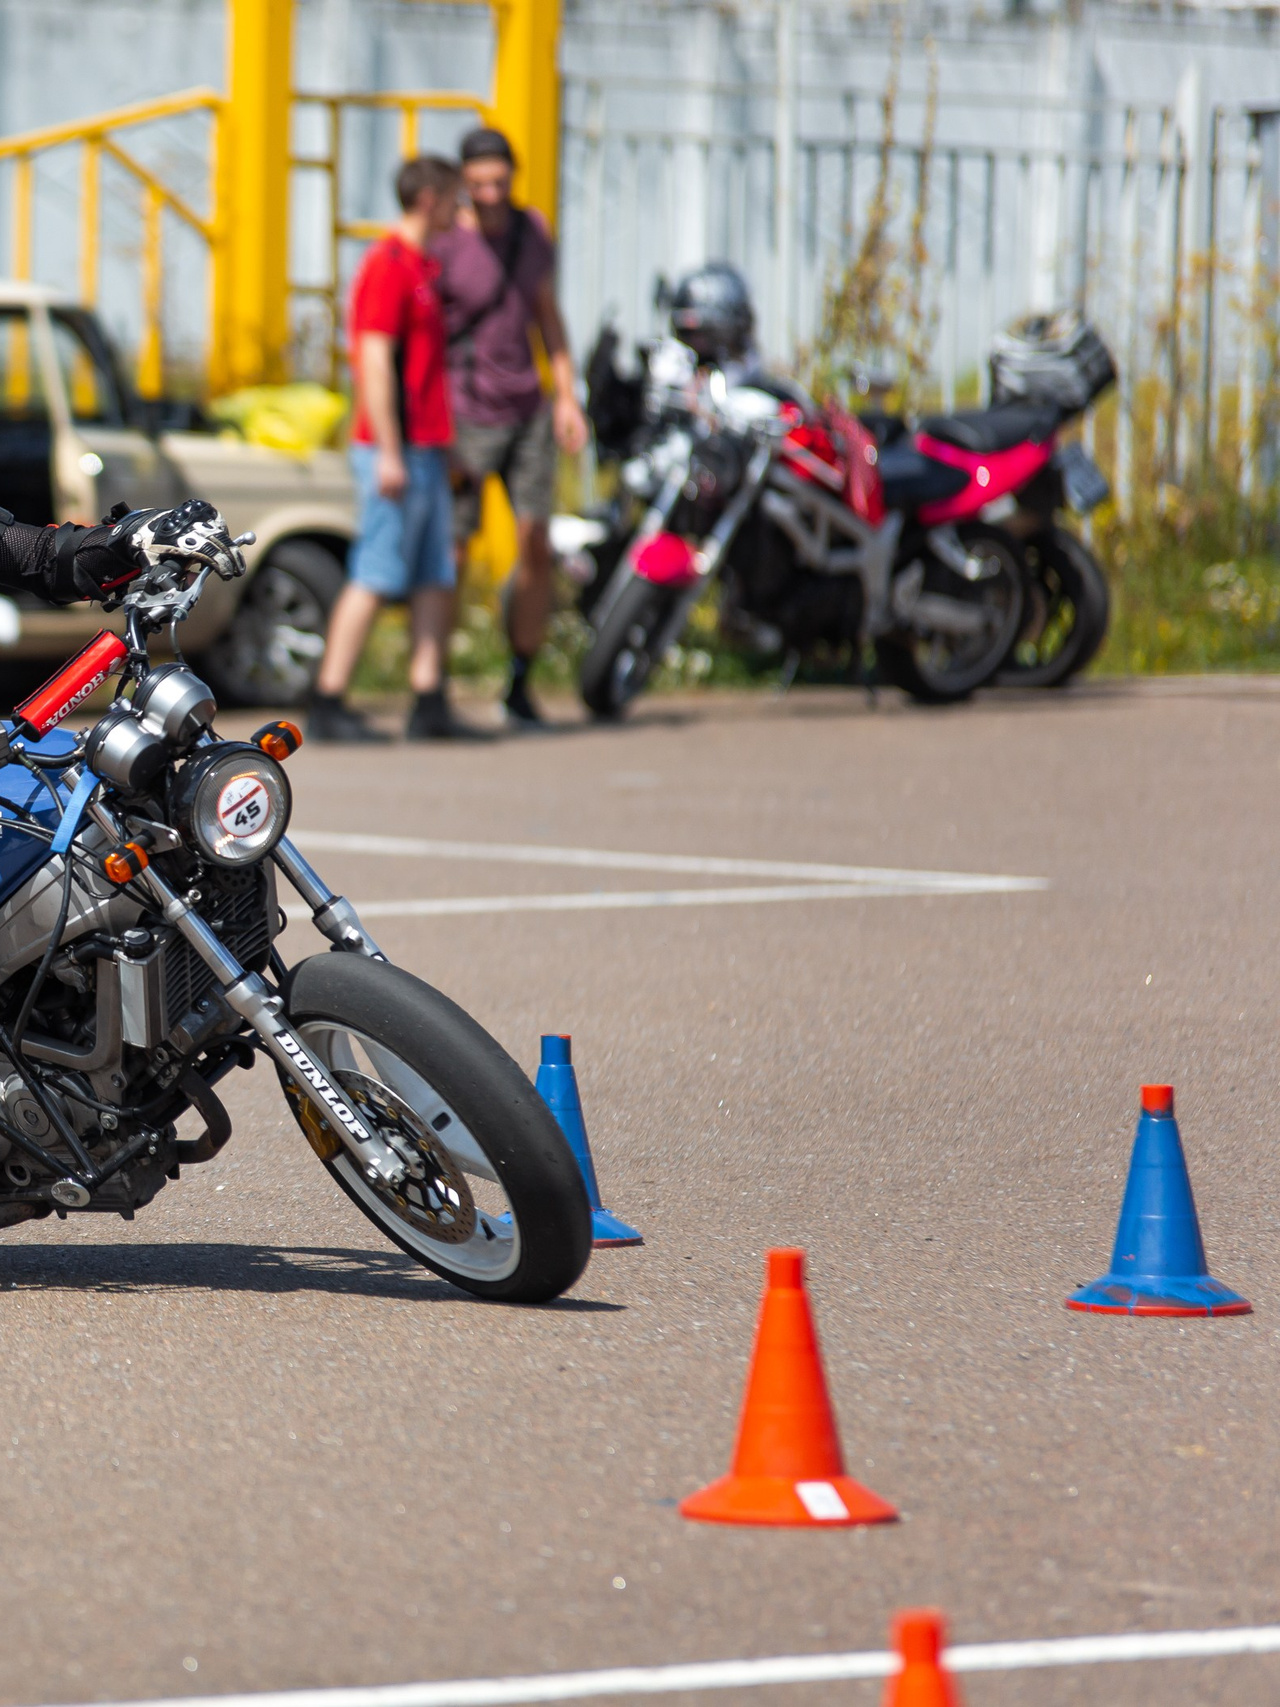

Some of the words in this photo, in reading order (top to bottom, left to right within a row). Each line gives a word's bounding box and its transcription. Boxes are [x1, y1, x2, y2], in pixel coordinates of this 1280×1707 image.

[45, 670, 106, 726] HONDA
[234, 800, 261, 826] 45
[275, 1033, 370, 1139] DUNLOP
